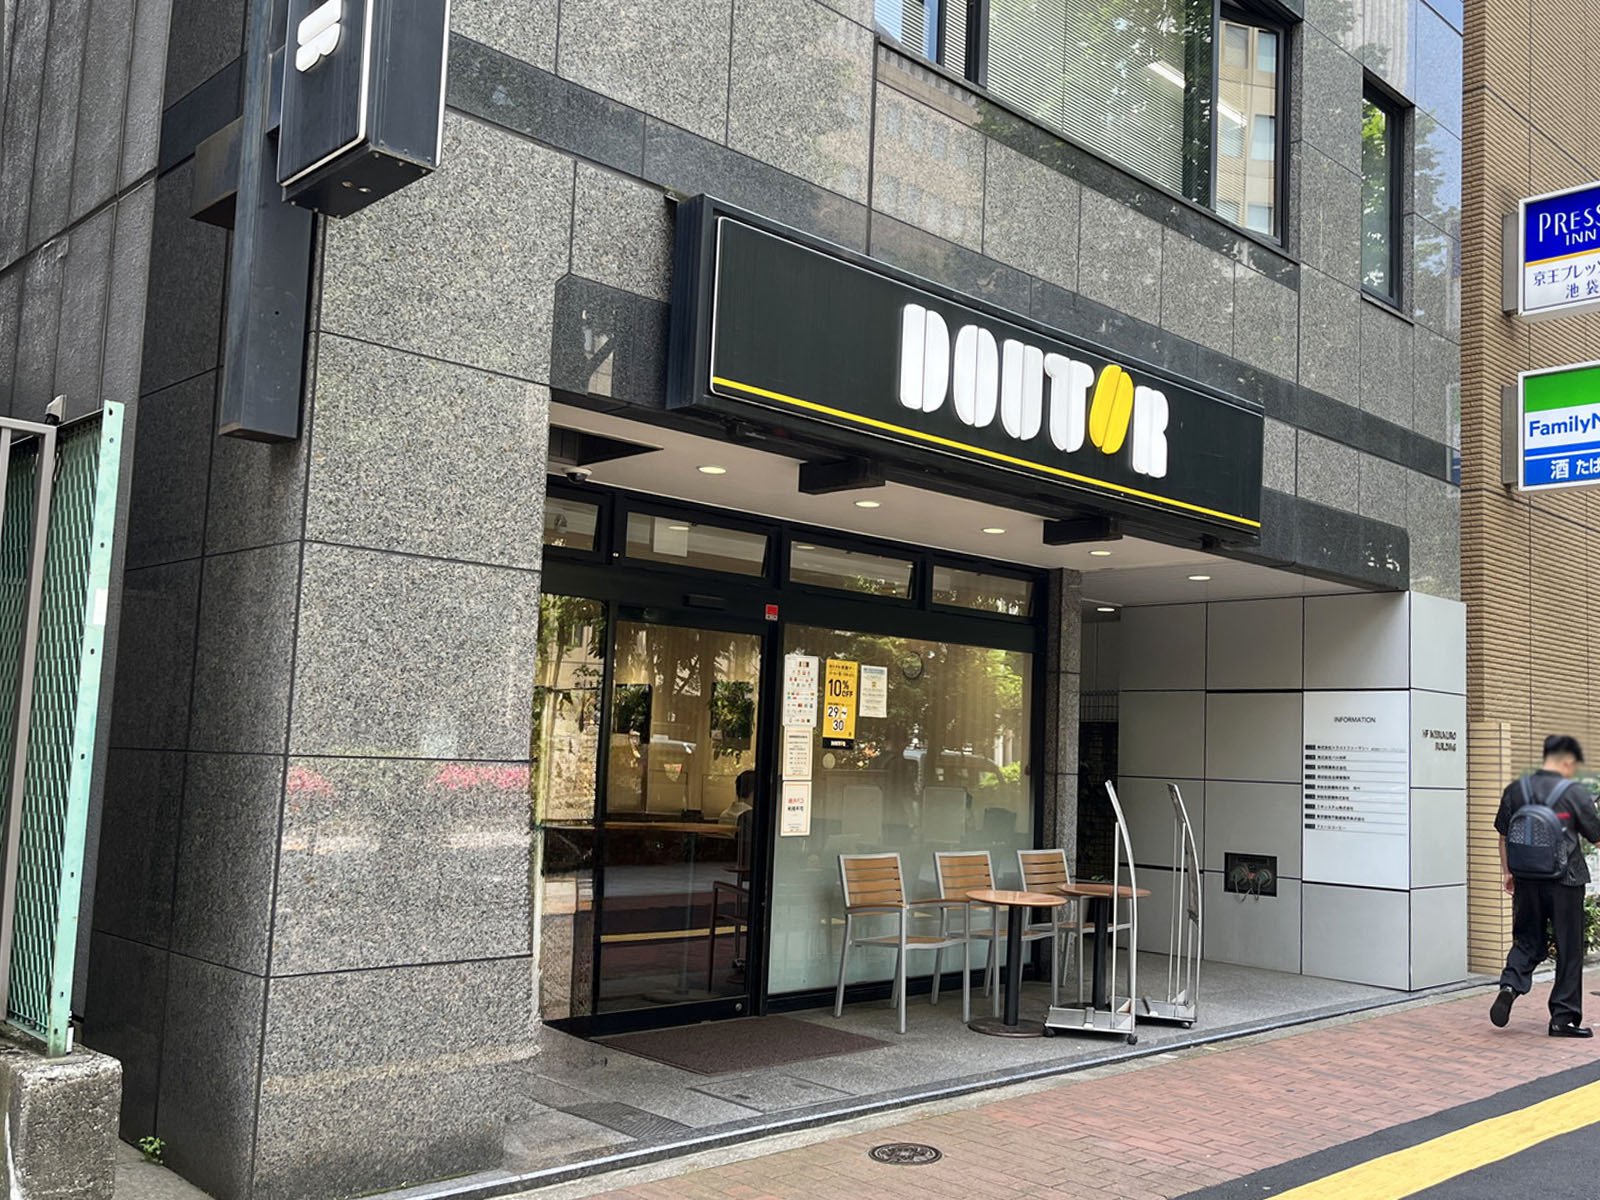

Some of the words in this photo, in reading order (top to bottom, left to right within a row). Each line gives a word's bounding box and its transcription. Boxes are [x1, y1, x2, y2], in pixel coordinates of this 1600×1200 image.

[1566, 229, 1597, 246] INN
[1533, 260, 1600, 287] 京王プレッ
[900, 303, 1169, 478] DOUTOR
[1550, 459, 1570, 480] 酒
[833, 719, 844, 731] 30
